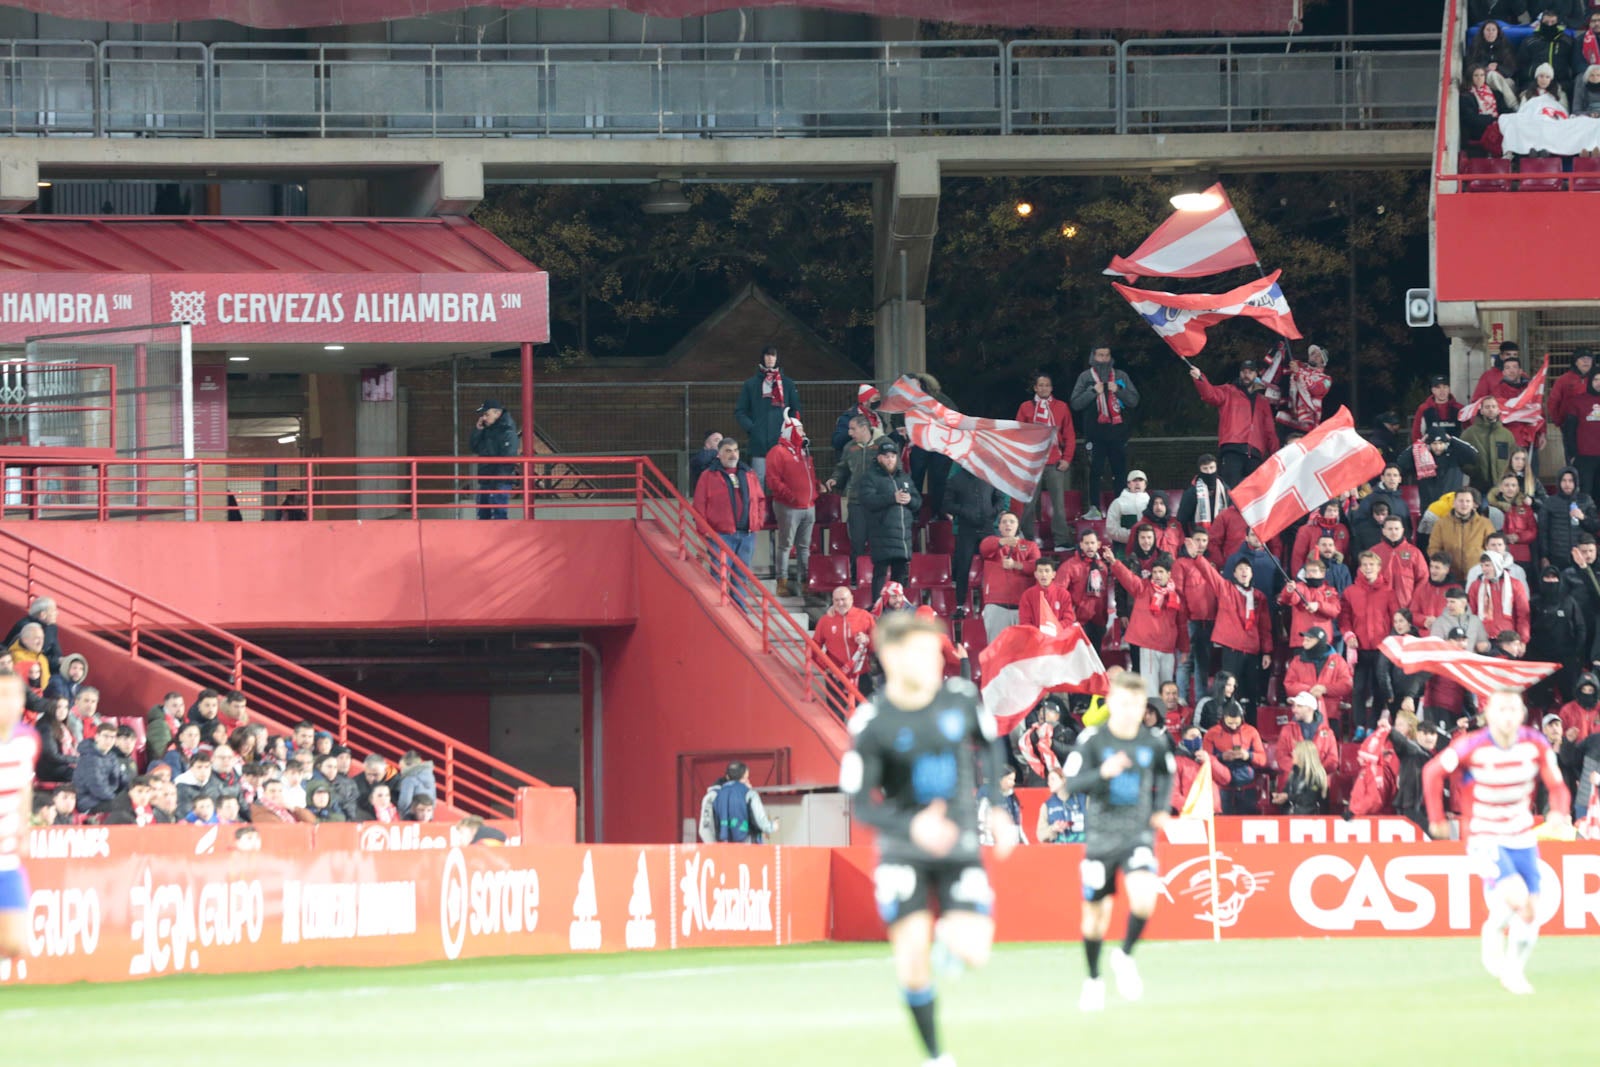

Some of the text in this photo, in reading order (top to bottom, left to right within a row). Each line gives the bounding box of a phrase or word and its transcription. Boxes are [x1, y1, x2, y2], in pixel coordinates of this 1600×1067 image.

[0, 292, 132, 323] HAMBRA SIN
[217, 292, 521, 323] CERVEZAS ALHAMBRA SIN
[470, 868, 539, 936] sorare
